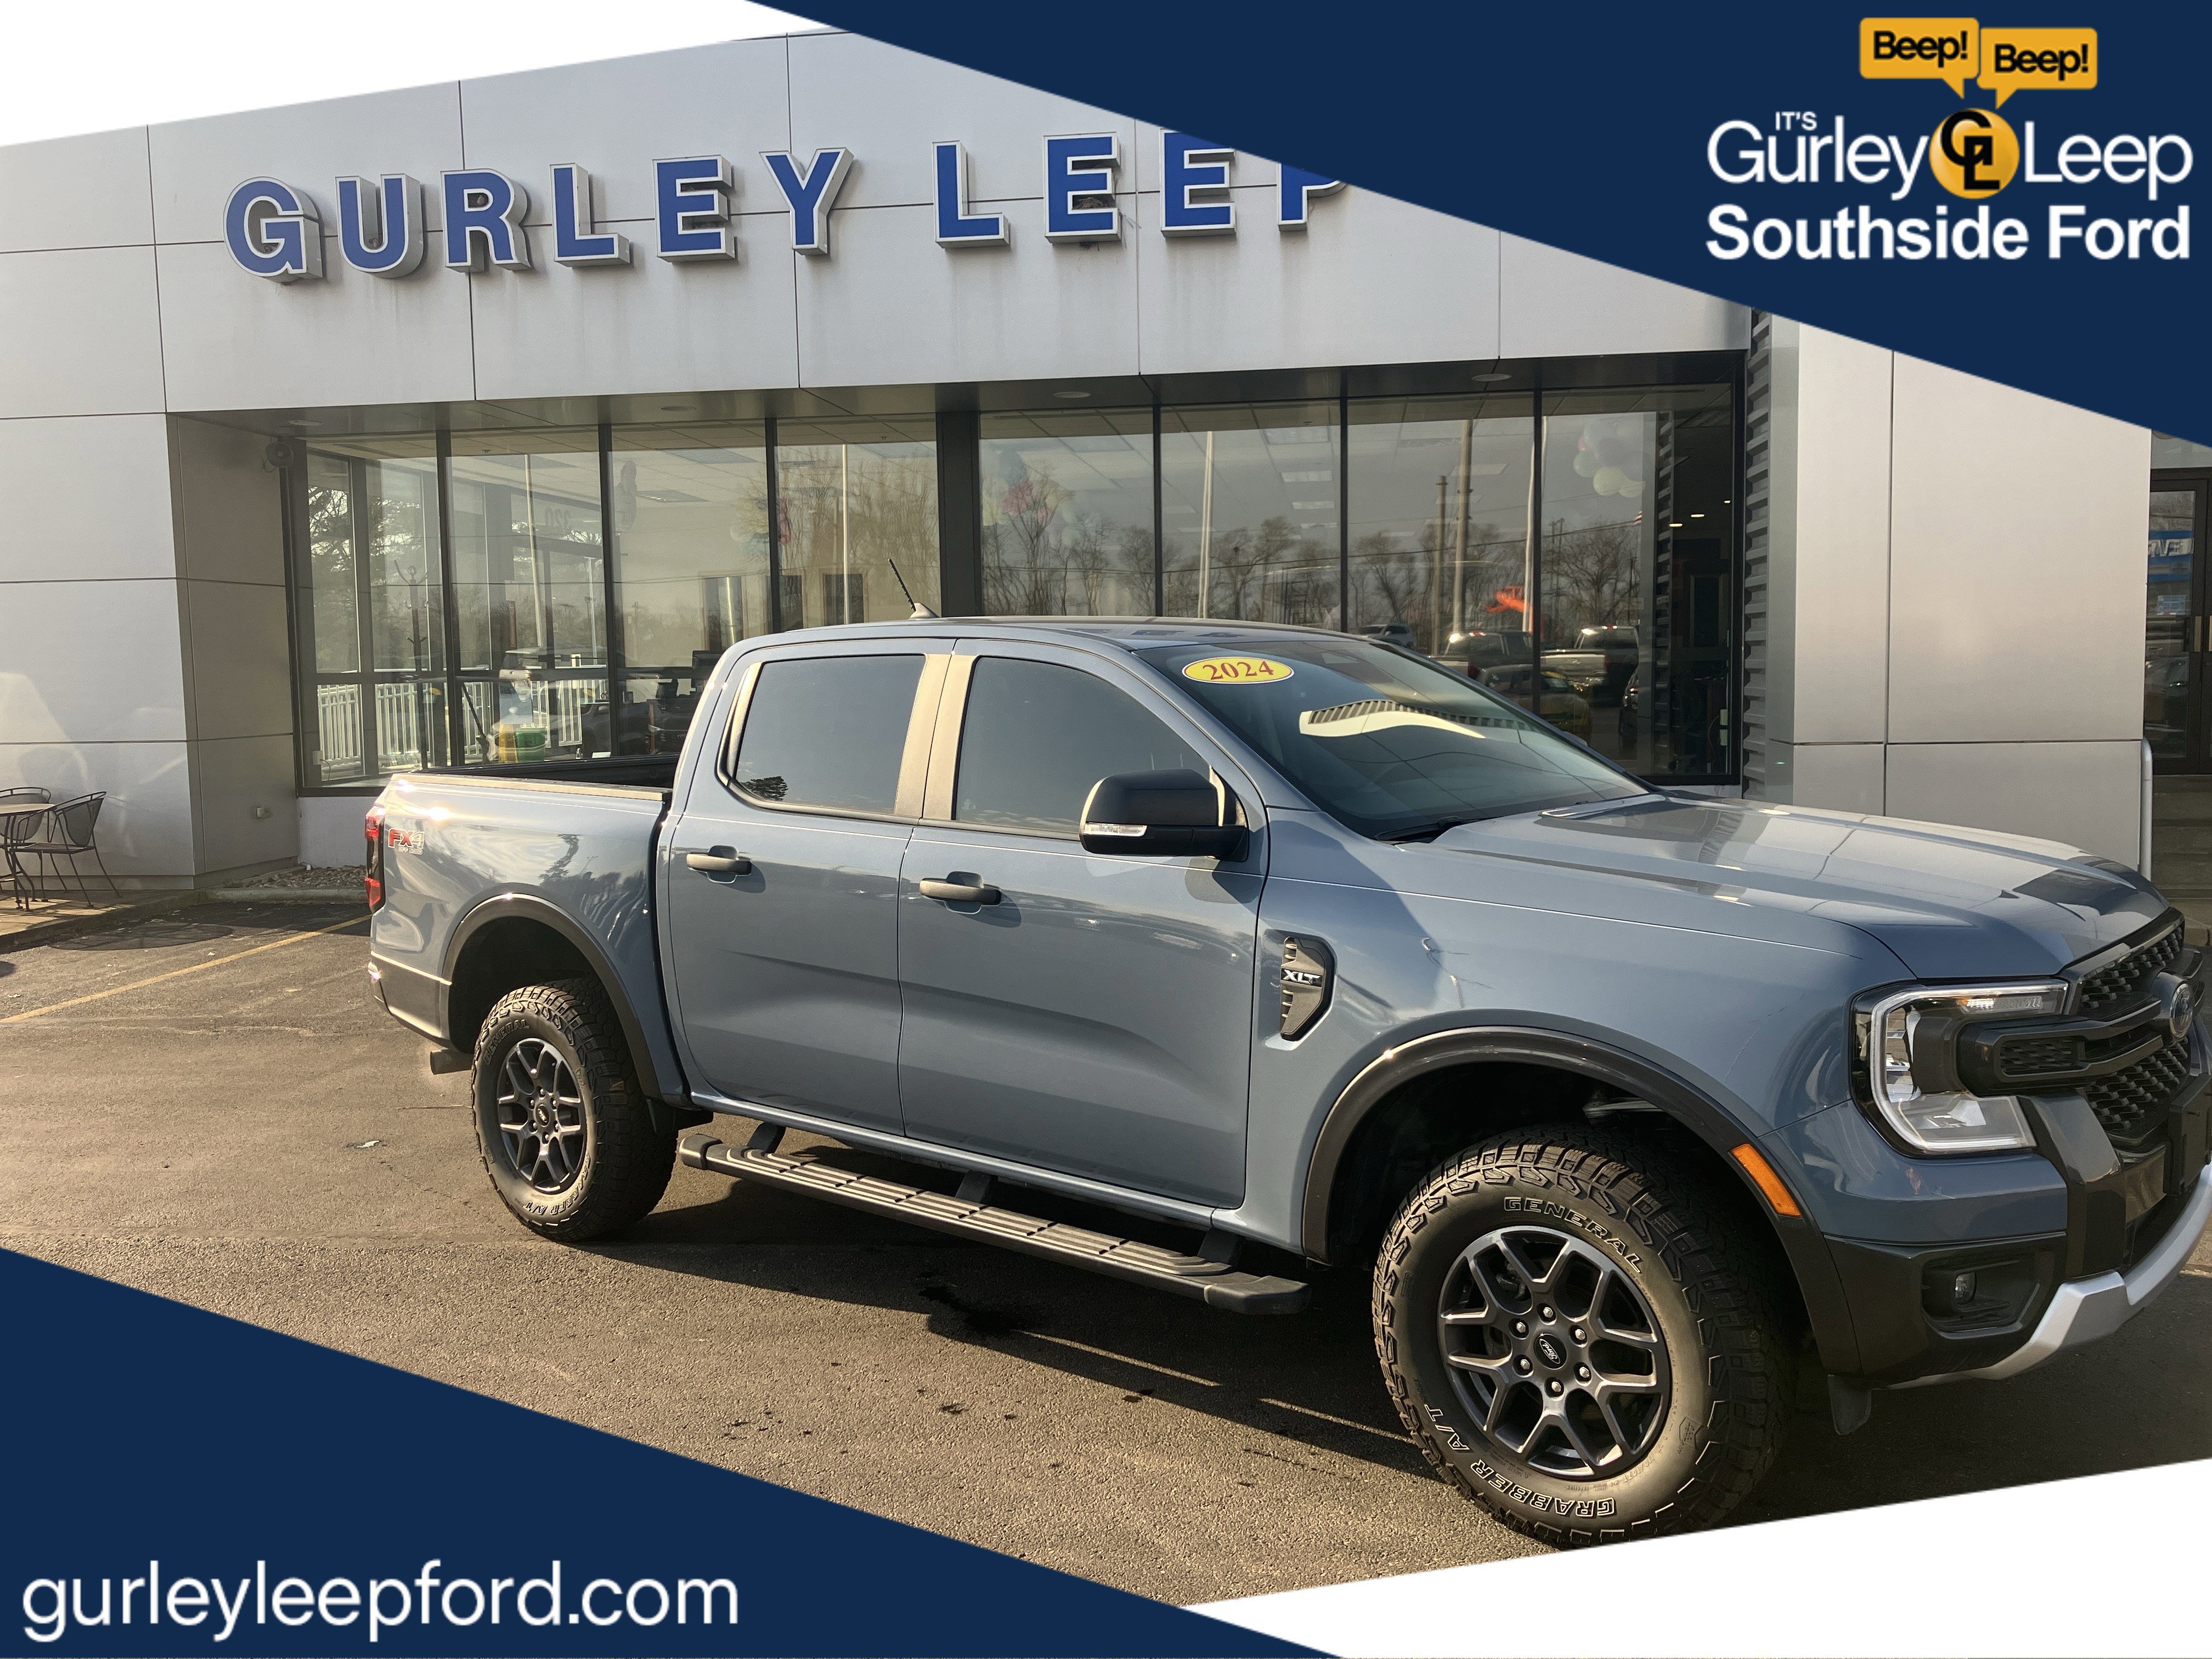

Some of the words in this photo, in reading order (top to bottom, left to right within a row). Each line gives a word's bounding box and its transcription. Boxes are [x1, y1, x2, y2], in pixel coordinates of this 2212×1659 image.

[223, 146, 854, 283] GURLEY
[1203, 661, 1274, 680] 2024
[388, 828, 425, 849] FX4
[1283, 969, 1321, 985] XLT
[483, 1019, 530, 1065] GENERAL
[523, 1201, 548, 1215] A/T
[1504, 1197, 1641, 1273] GENERAL
[1424, 1404, 1470, 1451] A/T
[1470, 1459, 1615, 1517] GRABBER
